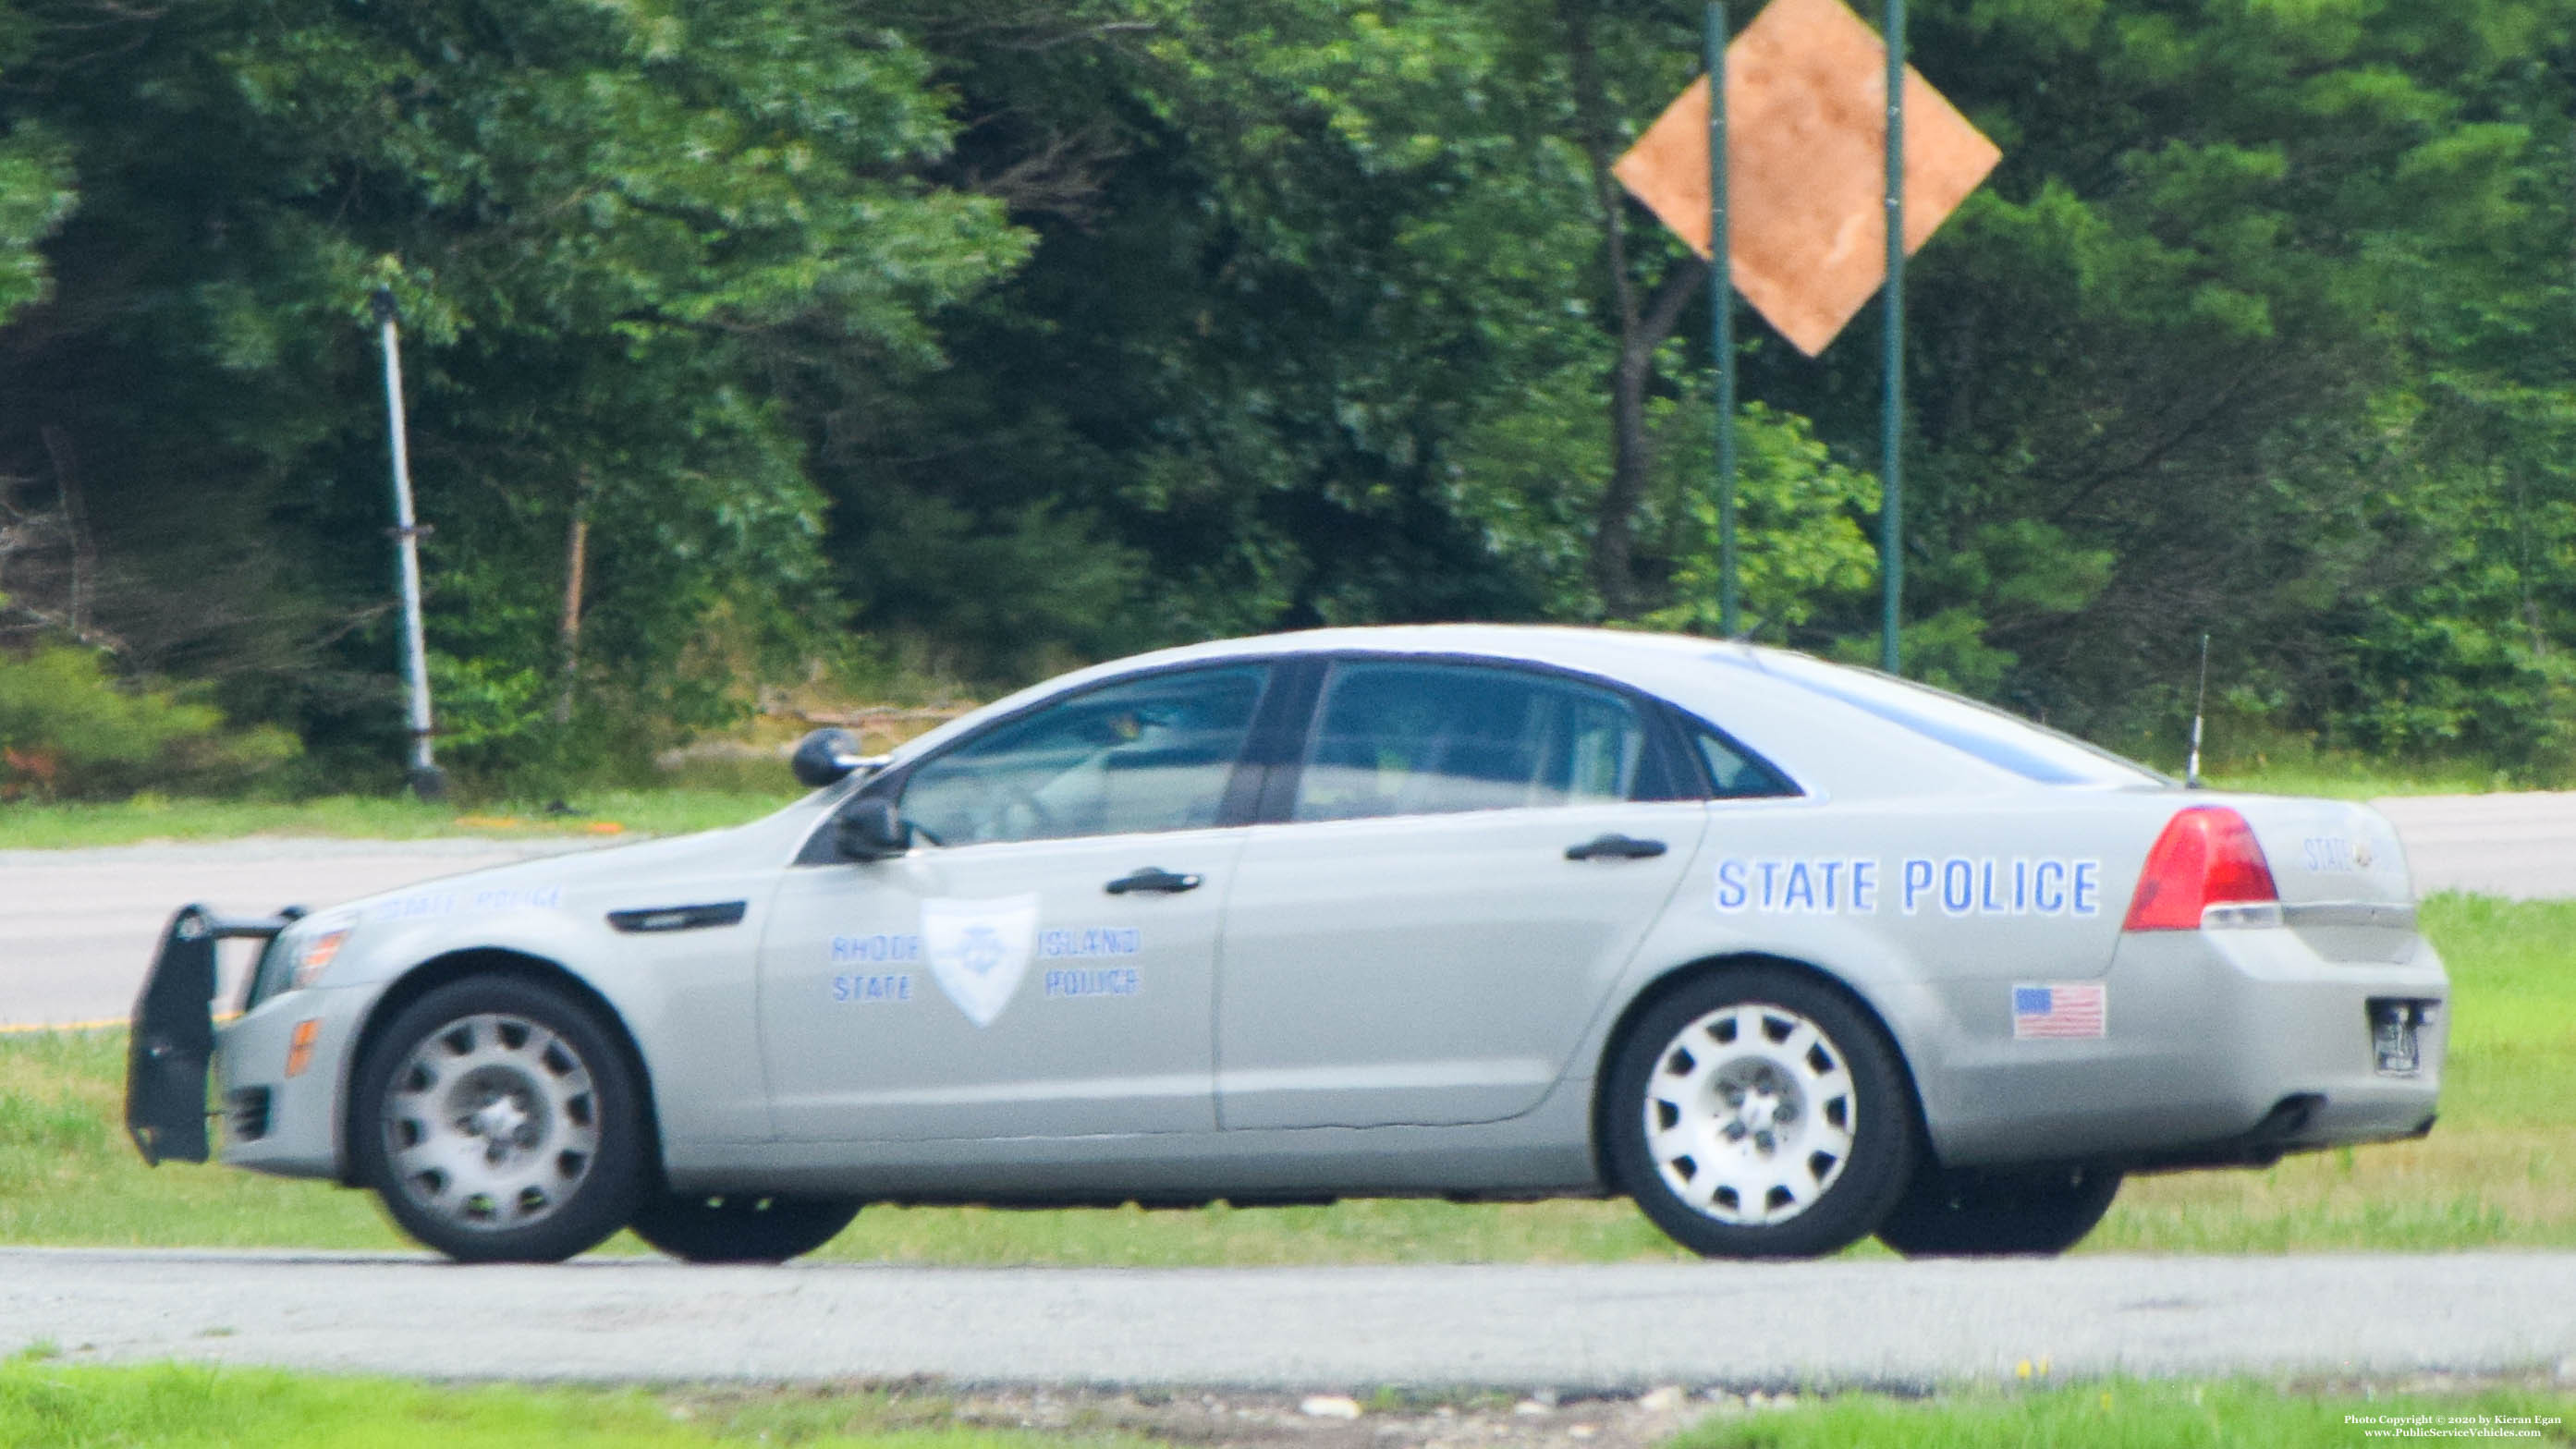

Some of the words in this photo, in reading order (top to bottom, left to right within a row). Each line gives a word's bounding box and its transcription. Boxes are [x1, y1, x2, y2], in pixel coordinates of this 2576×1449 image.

[1716, 858, 1876, 911] STATE
[1903, 858, 2099, 914] POLICE
[831, 934, 919, 962] RHODE
[1037, 929, 1141, 956] ISLAND
[832, 974, 911, 1001] STATE
[1045, 968, 1140, 996] POLICE
